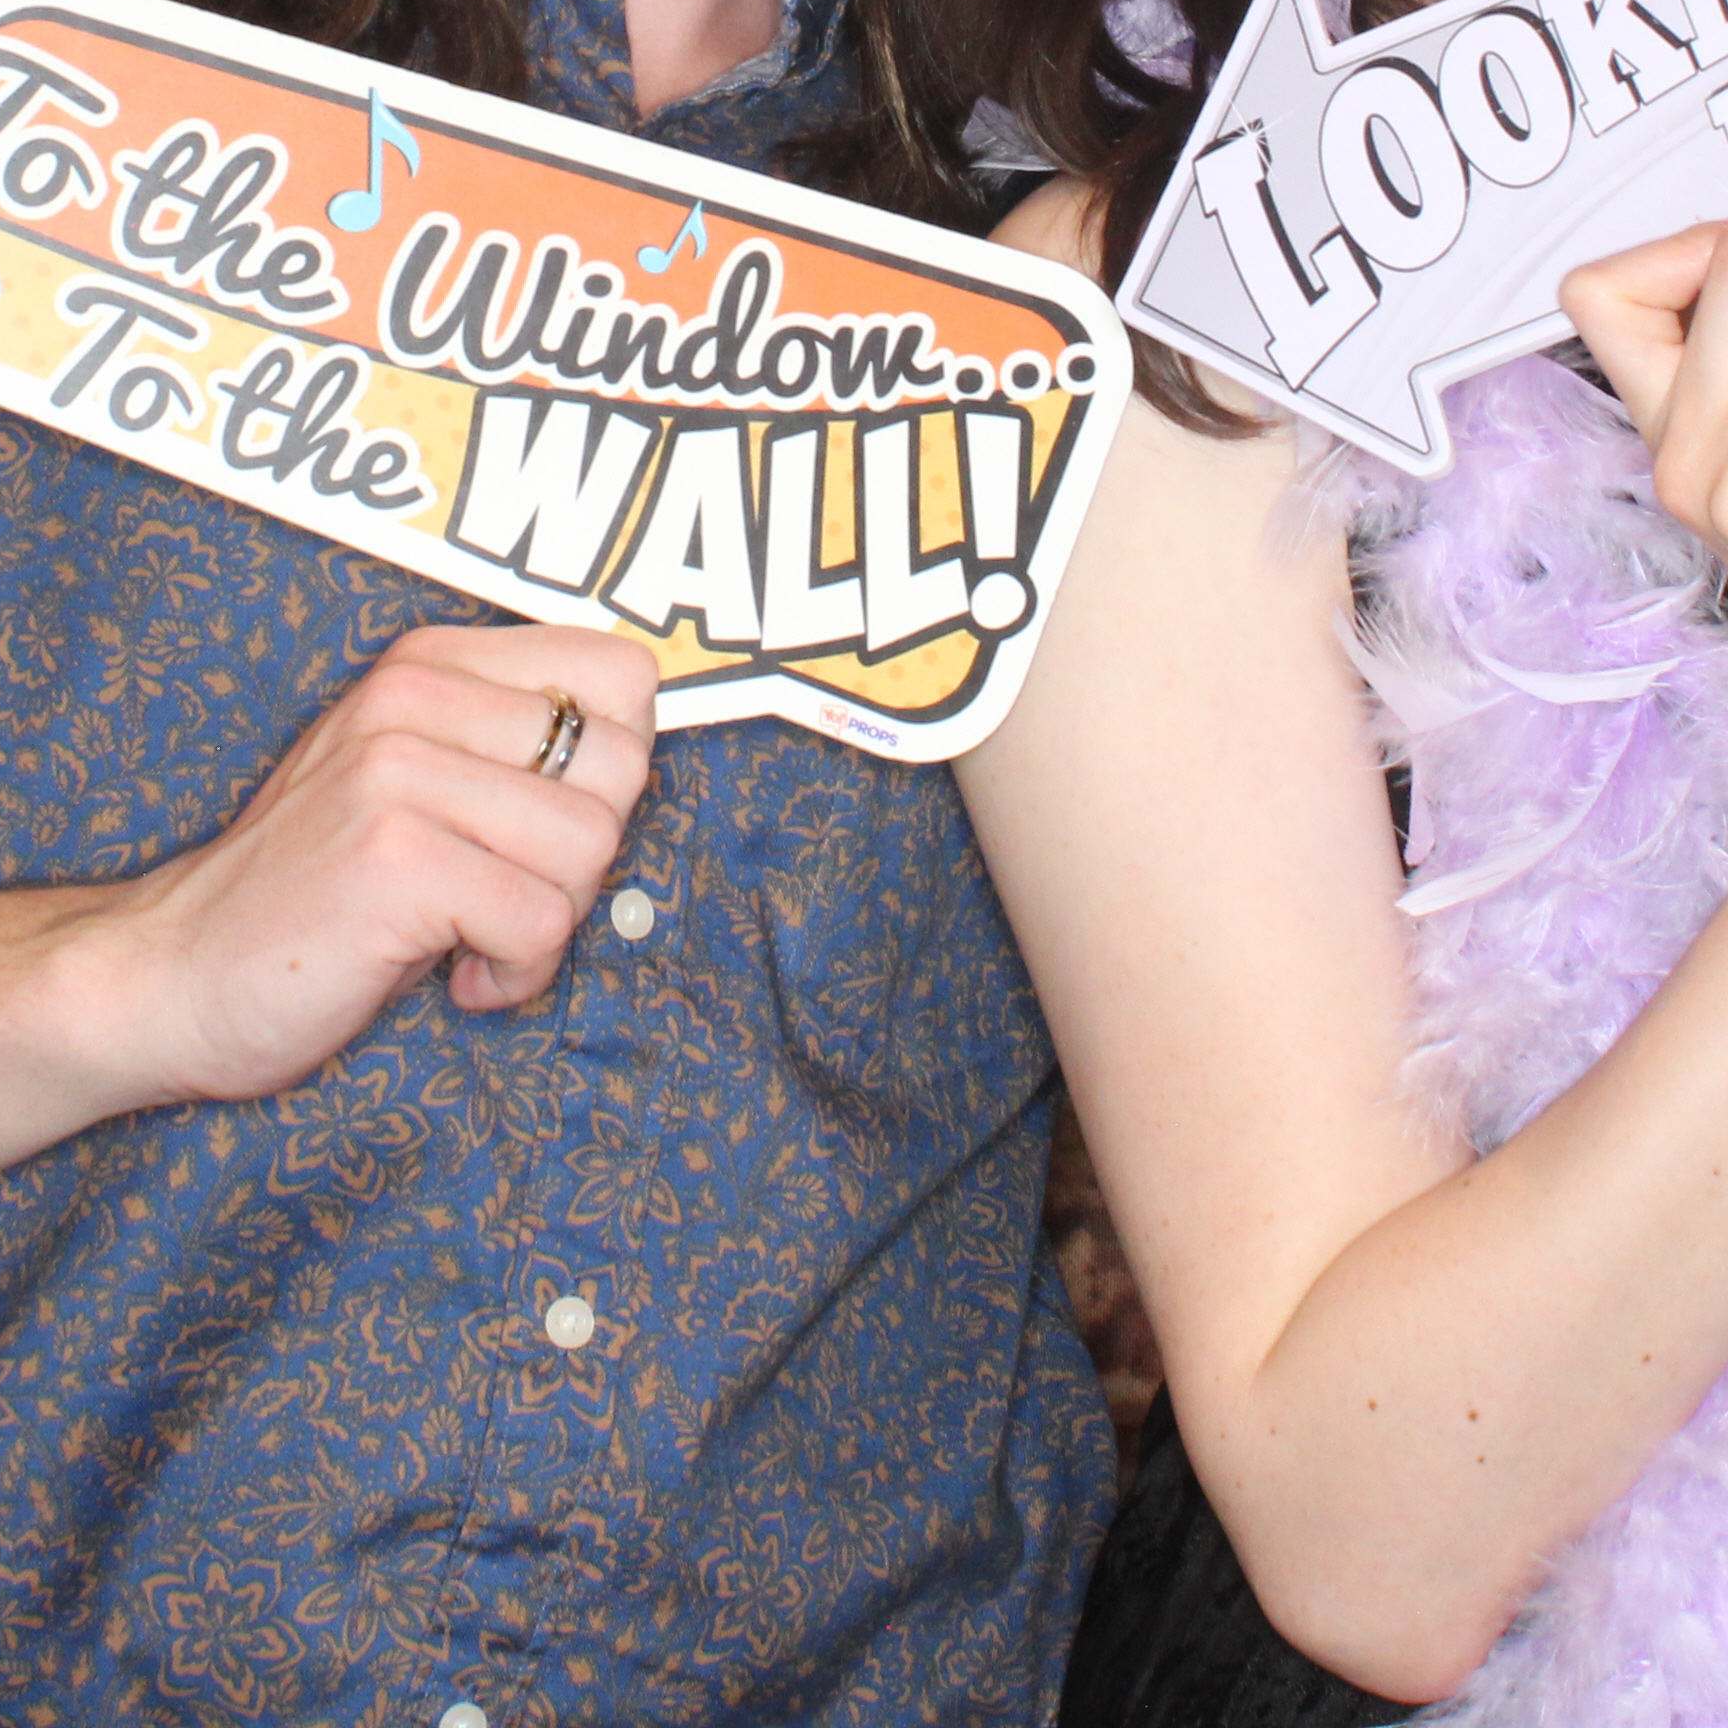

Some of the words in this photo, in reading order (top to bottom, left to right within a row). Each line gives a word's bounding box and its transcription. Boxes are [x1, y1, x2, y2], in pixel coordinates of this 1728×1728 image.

[122, 129, 338, 312] the
[388, 225, 1094, 398] Window...
[50, 287, 199, 429] To
[216, 347, 423, 510] the
[445, 392, 1040, 666] WALL!
[848, 717, 899, 747] PROPS
